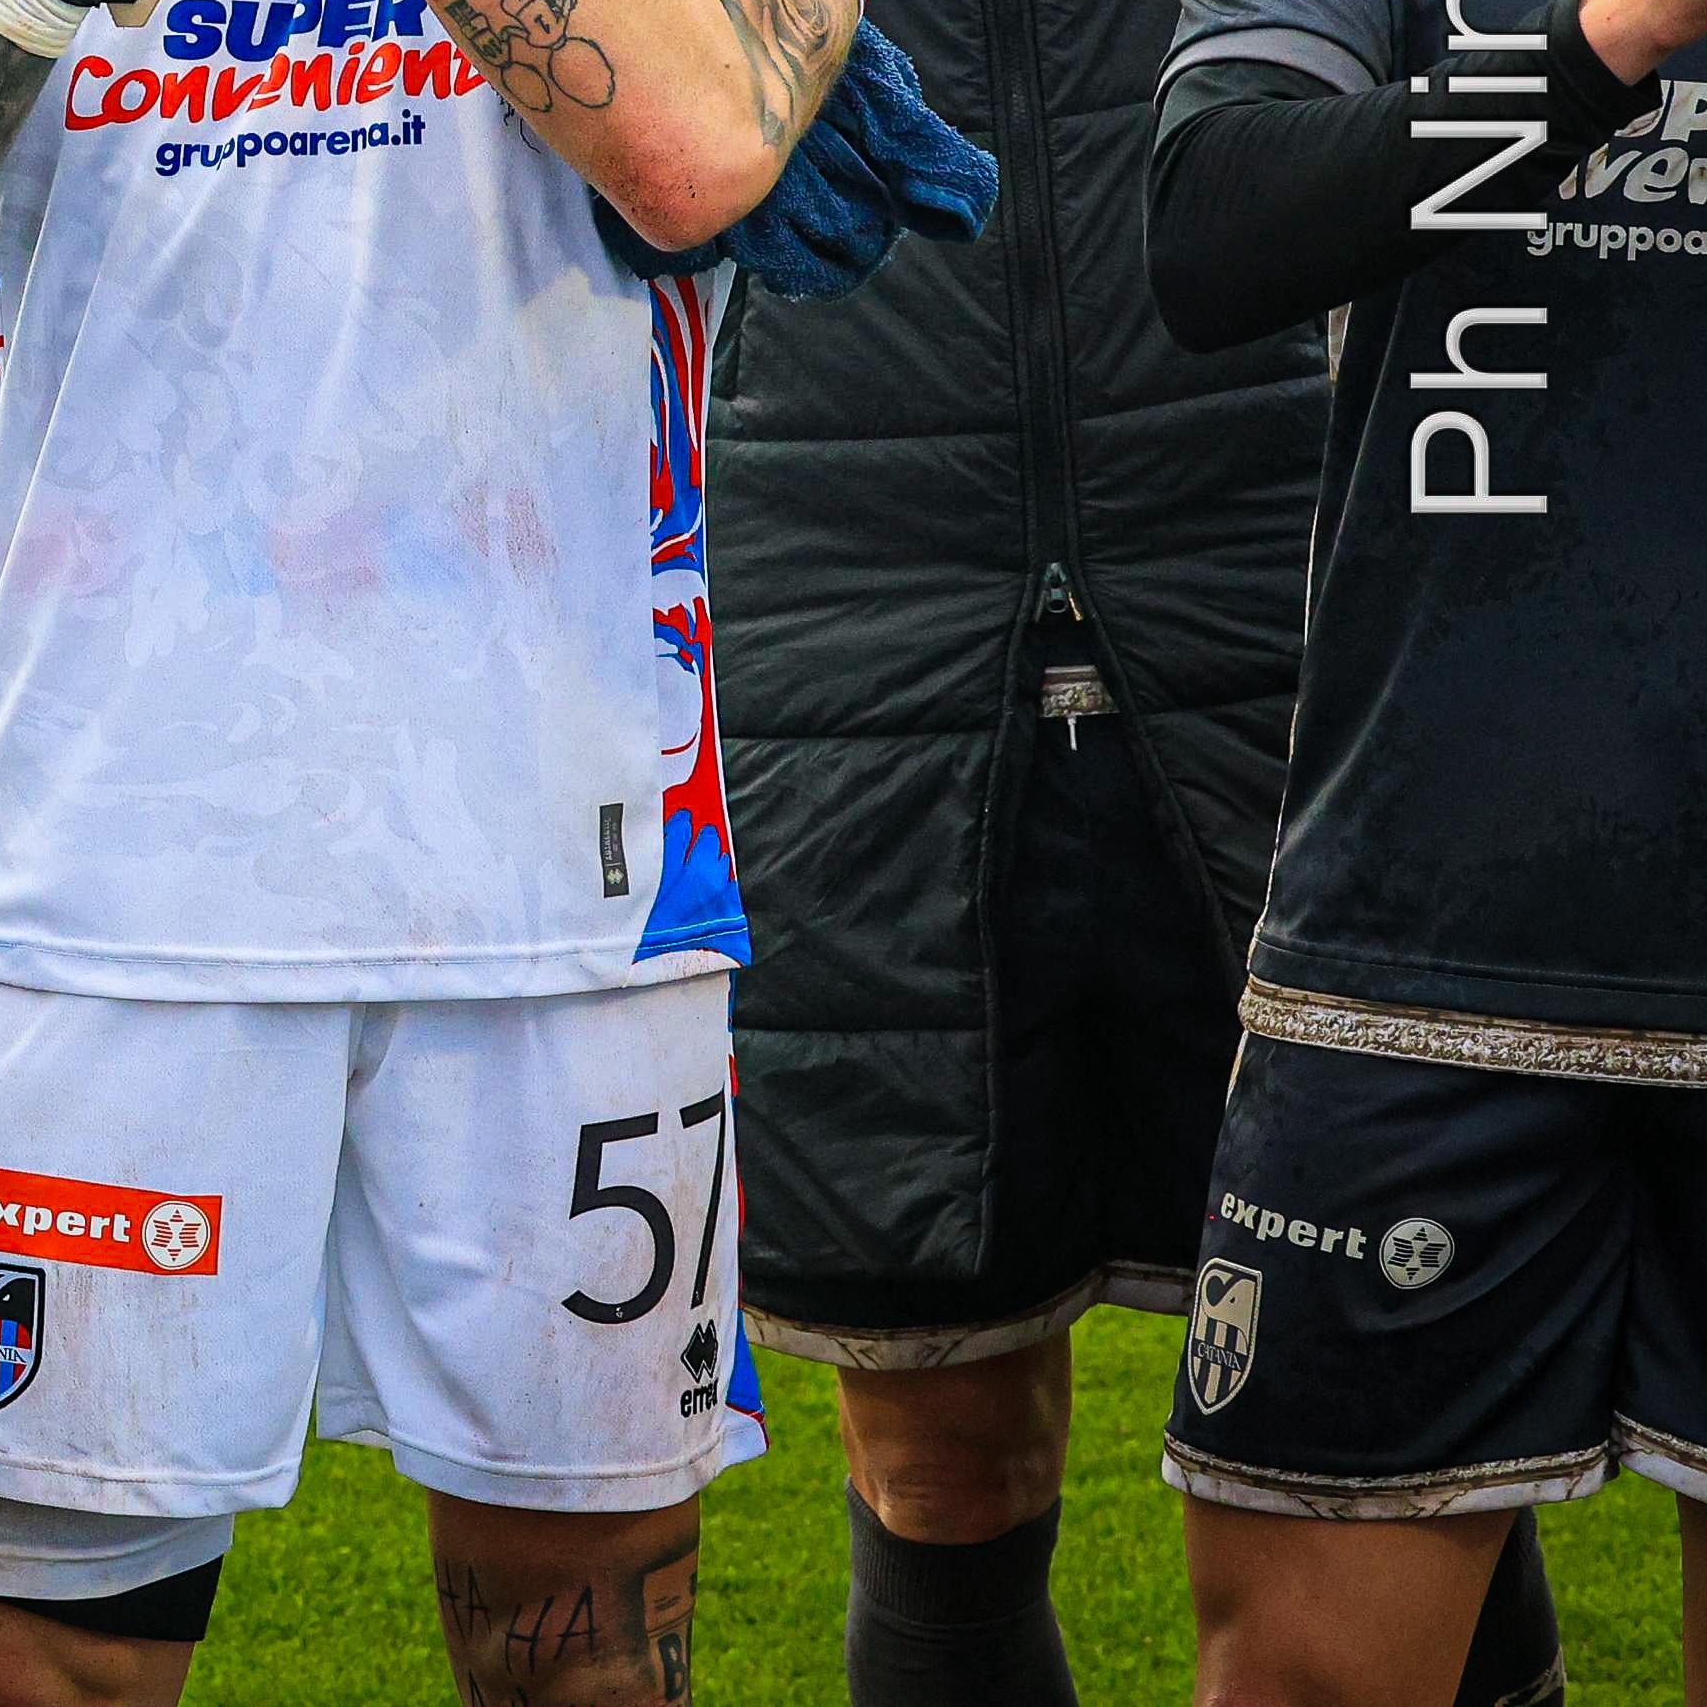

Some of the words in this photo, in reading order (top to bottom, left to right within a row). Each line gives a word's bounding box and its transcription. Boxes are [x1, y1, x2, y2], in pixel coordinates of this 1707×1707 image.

[155, 108, 426, 177] gruppoarena.it
[561, 1086, 726, 1325] 57
[1220, 1193, 1367, 1260] expert
[1197, 1342, 1243, 1371] CATANIA
